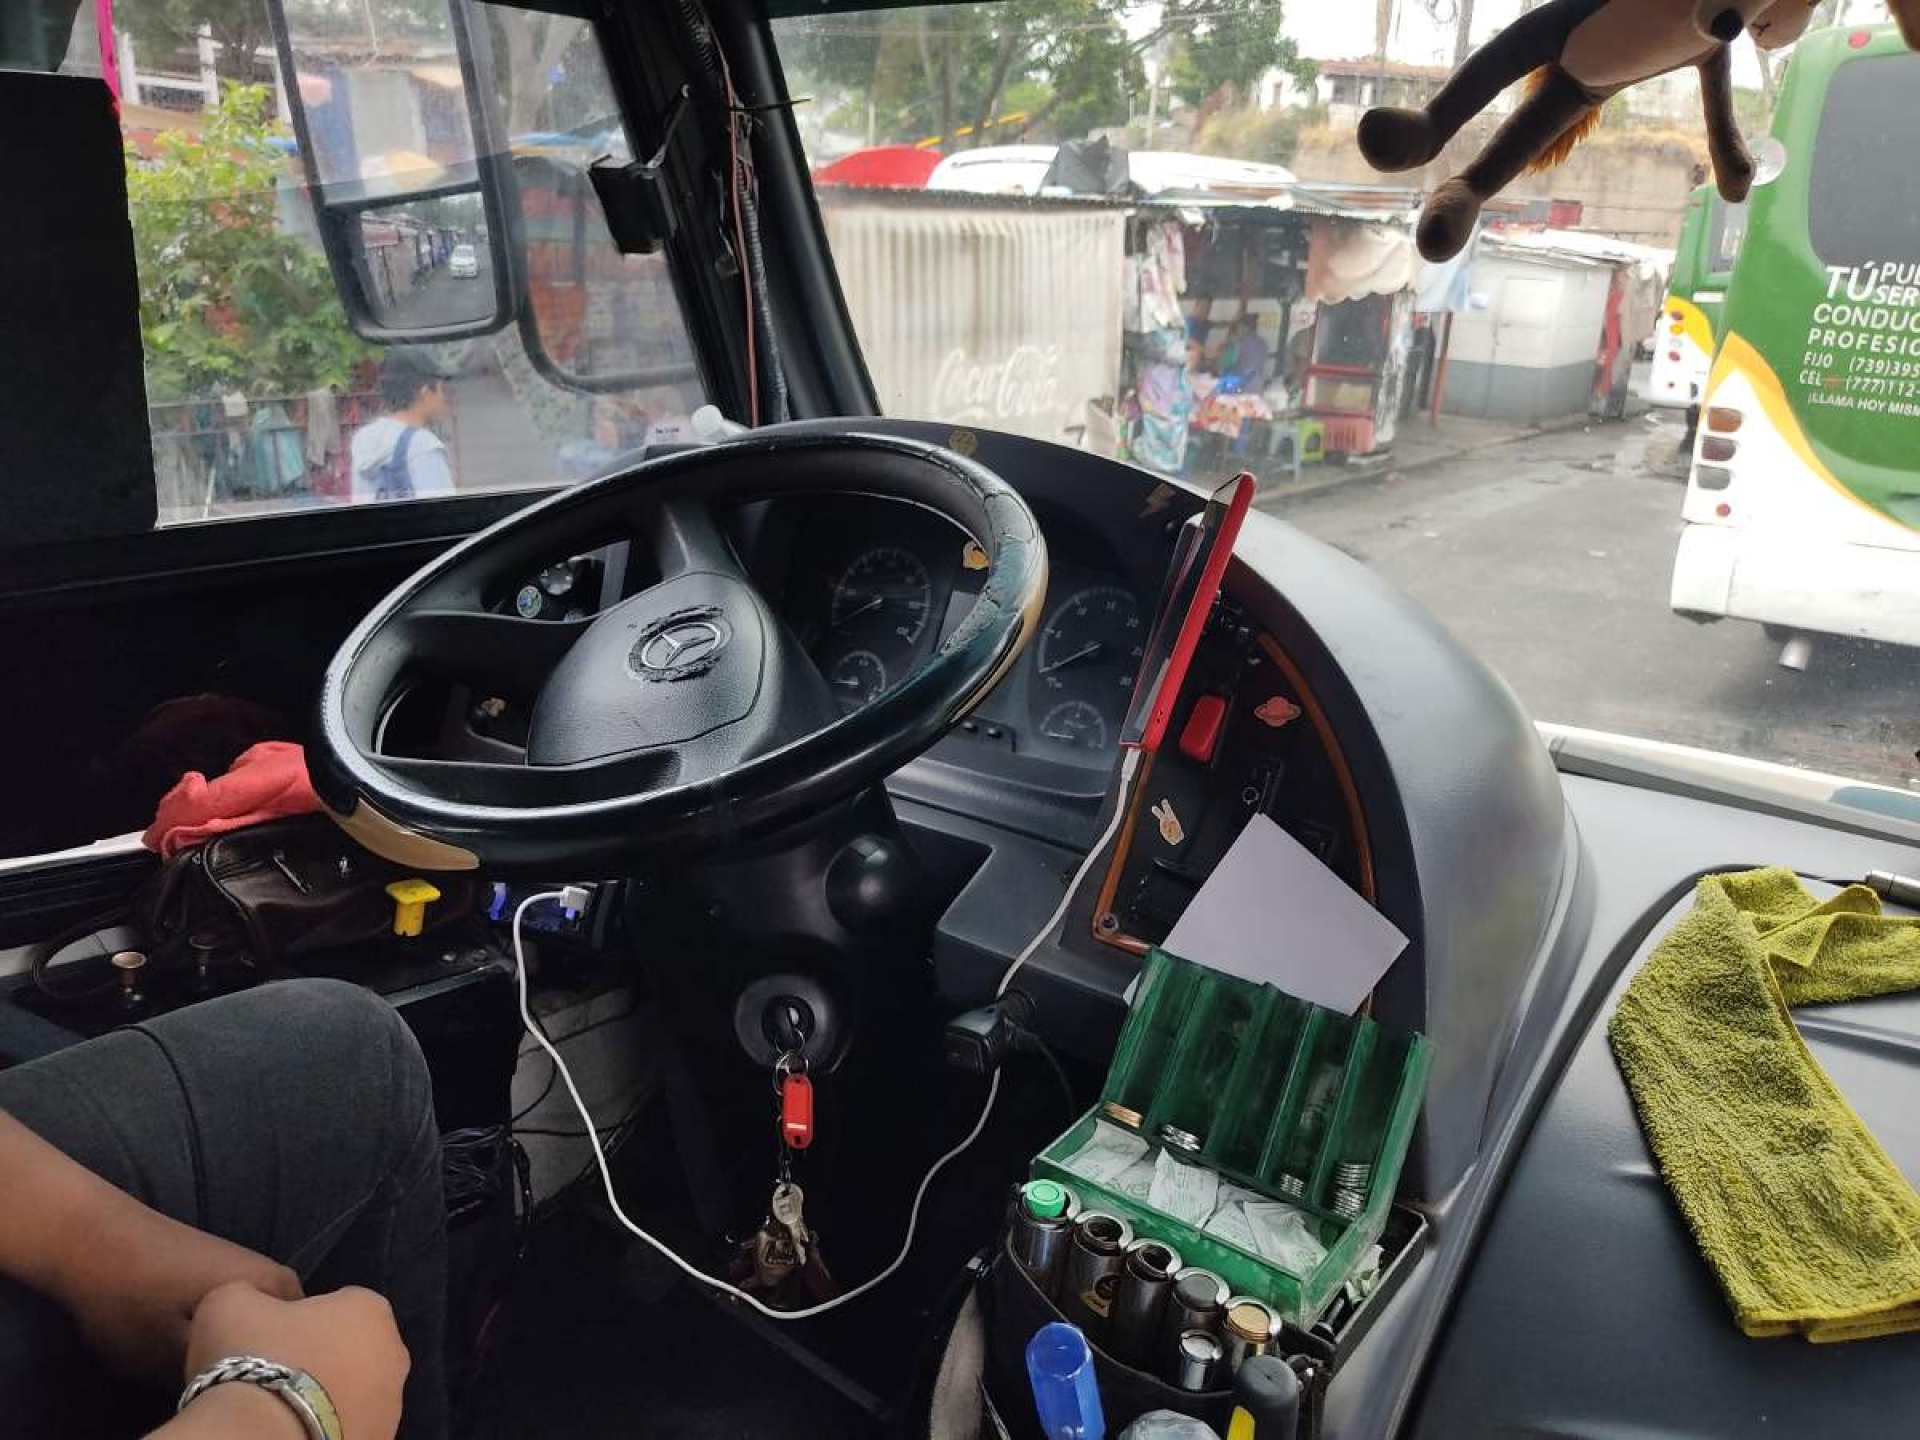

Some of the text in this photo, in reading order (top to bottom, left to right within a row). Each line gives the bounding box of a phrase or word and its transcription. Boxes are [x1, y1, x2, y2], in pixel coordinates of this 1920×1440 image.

[1825, 261, 1880, 301] TÚ
[1803, 351, 1833, 368] FIJO
[1799, 369, 1821, 386] CEL
[1857, 397, 1887, 412] HOY
